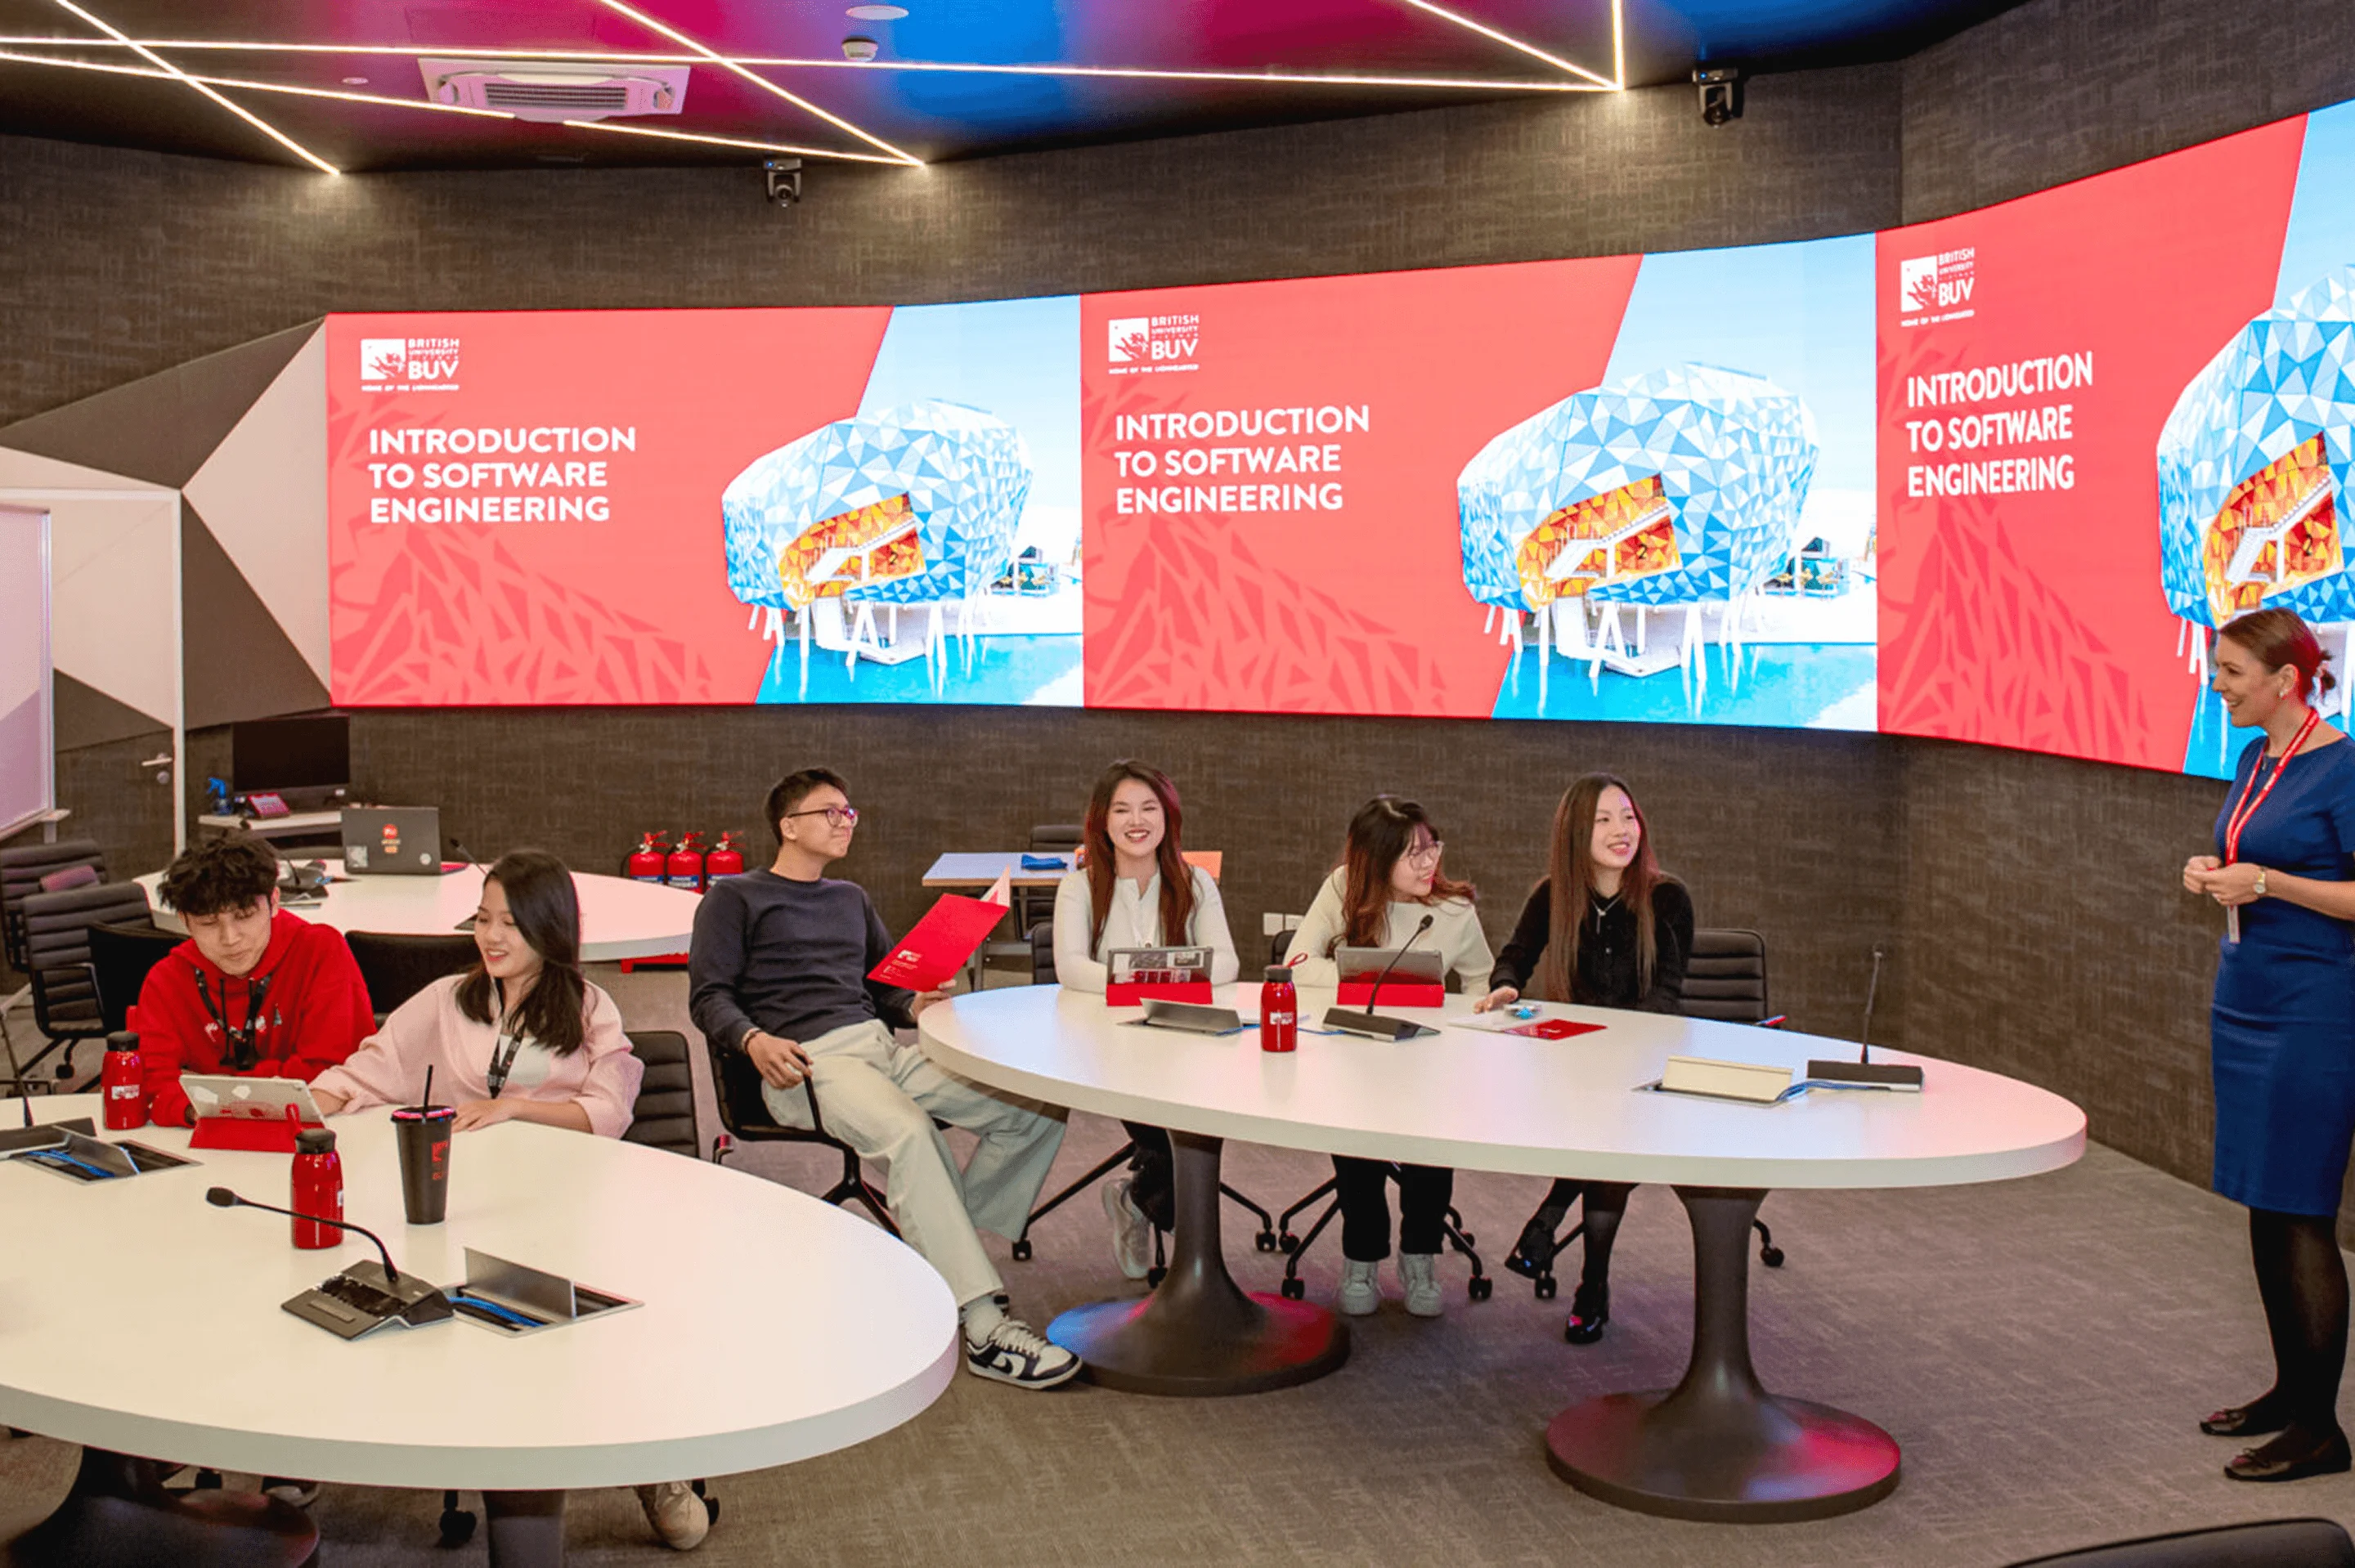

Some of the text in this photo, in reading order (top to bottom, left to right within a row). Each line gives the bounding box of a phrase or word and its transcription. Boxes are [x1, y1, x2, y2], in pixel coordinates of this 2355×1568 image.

[1938, 247, 1975, 266] BRITISH
[1938, 277, 1975, 307] BUV
[1151, 315, 1199, 326] BRITISH
[408, 338, 460, 348] BRITISH
[1151, 338, 1199, 360] BUV
[408, 360, 460, 380] BUV
[1908, 351, 2093, 408] INTRODUCTION
[1116, 405, 1370, 441] INTRODUCTION
[1906, 404, 2074, 453] TO SOFTWARE
[370, 427, 636, 455] INTRODUCTION
[1115, 444, 1342, 477] TO SOFTWARE
[367, 461, 608, 490] TO SOFTWARE
[1908, 455, 2075, 498] ENGINEERING
[370, 495, 610, 524] ENGINEERING
[1116, 482, 1343, 514] ENGINEERING
